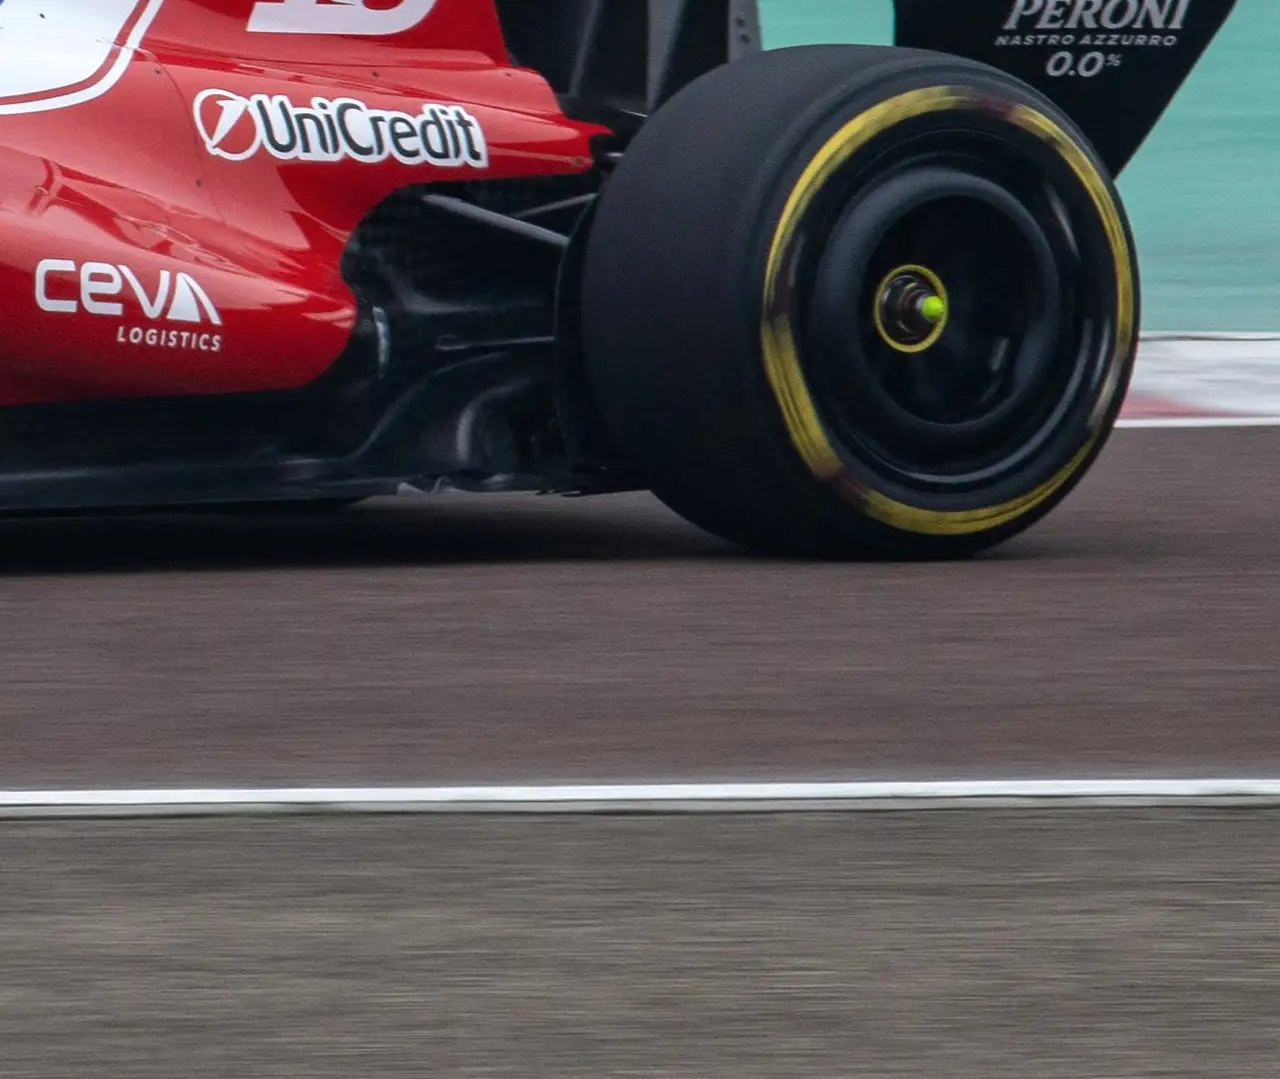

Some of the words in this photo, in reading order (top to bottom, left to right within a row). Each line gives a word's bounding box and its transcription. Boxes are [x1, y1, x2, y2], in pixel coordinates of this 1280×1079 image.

[994, 34, 1075, 46] NASTRO
[1077, 34, 1178, 46] AZZURRO
[253, 95, 485, 166] UniCredit
[116, 325, 222, 352] LOGISTICS
